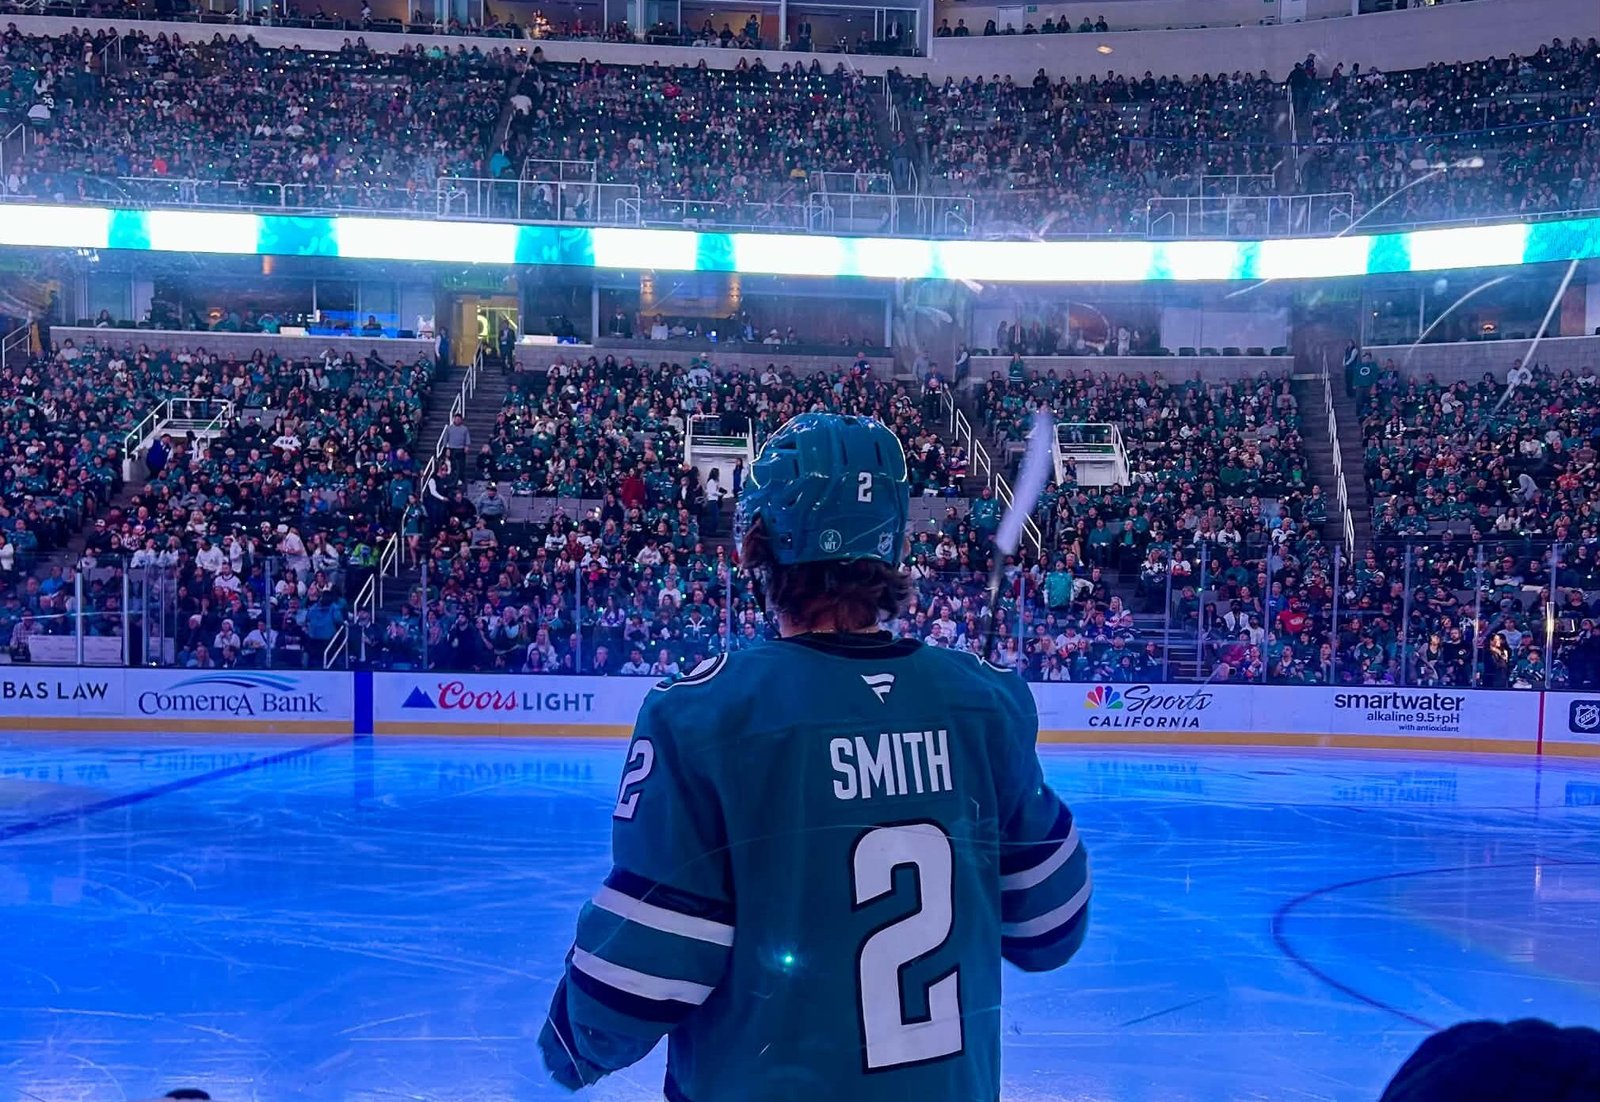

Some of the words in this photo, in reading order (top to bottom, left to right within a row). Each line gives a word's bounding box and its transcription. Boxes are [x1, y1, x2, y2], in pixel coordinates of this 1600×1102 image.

[858, 472, 872, 502] 2
[2, 681, 48, 699] BAS
[57, 682, 108, 700] LAW
[261, 692, 323, 713] Bank
[438, 681, 517, 711] Coors
[523, 693, 594, 712] LIGHT
[1124, 685, 1213, 716] Sports
[1334, 692, 1466, 712] smartwater
[1089, 716, 1200, 728] CALIFORNIA
[1367, 711, 1413, 722] alkaline
[1416, 712, 1460, 725] 9.5+pH
[1416, 725, 1459, 733] antioxidant
[829, 730, 953, 800] SMITH
[613, 739, 655, 819] 2
[854, 823, 962, 1069] 2
